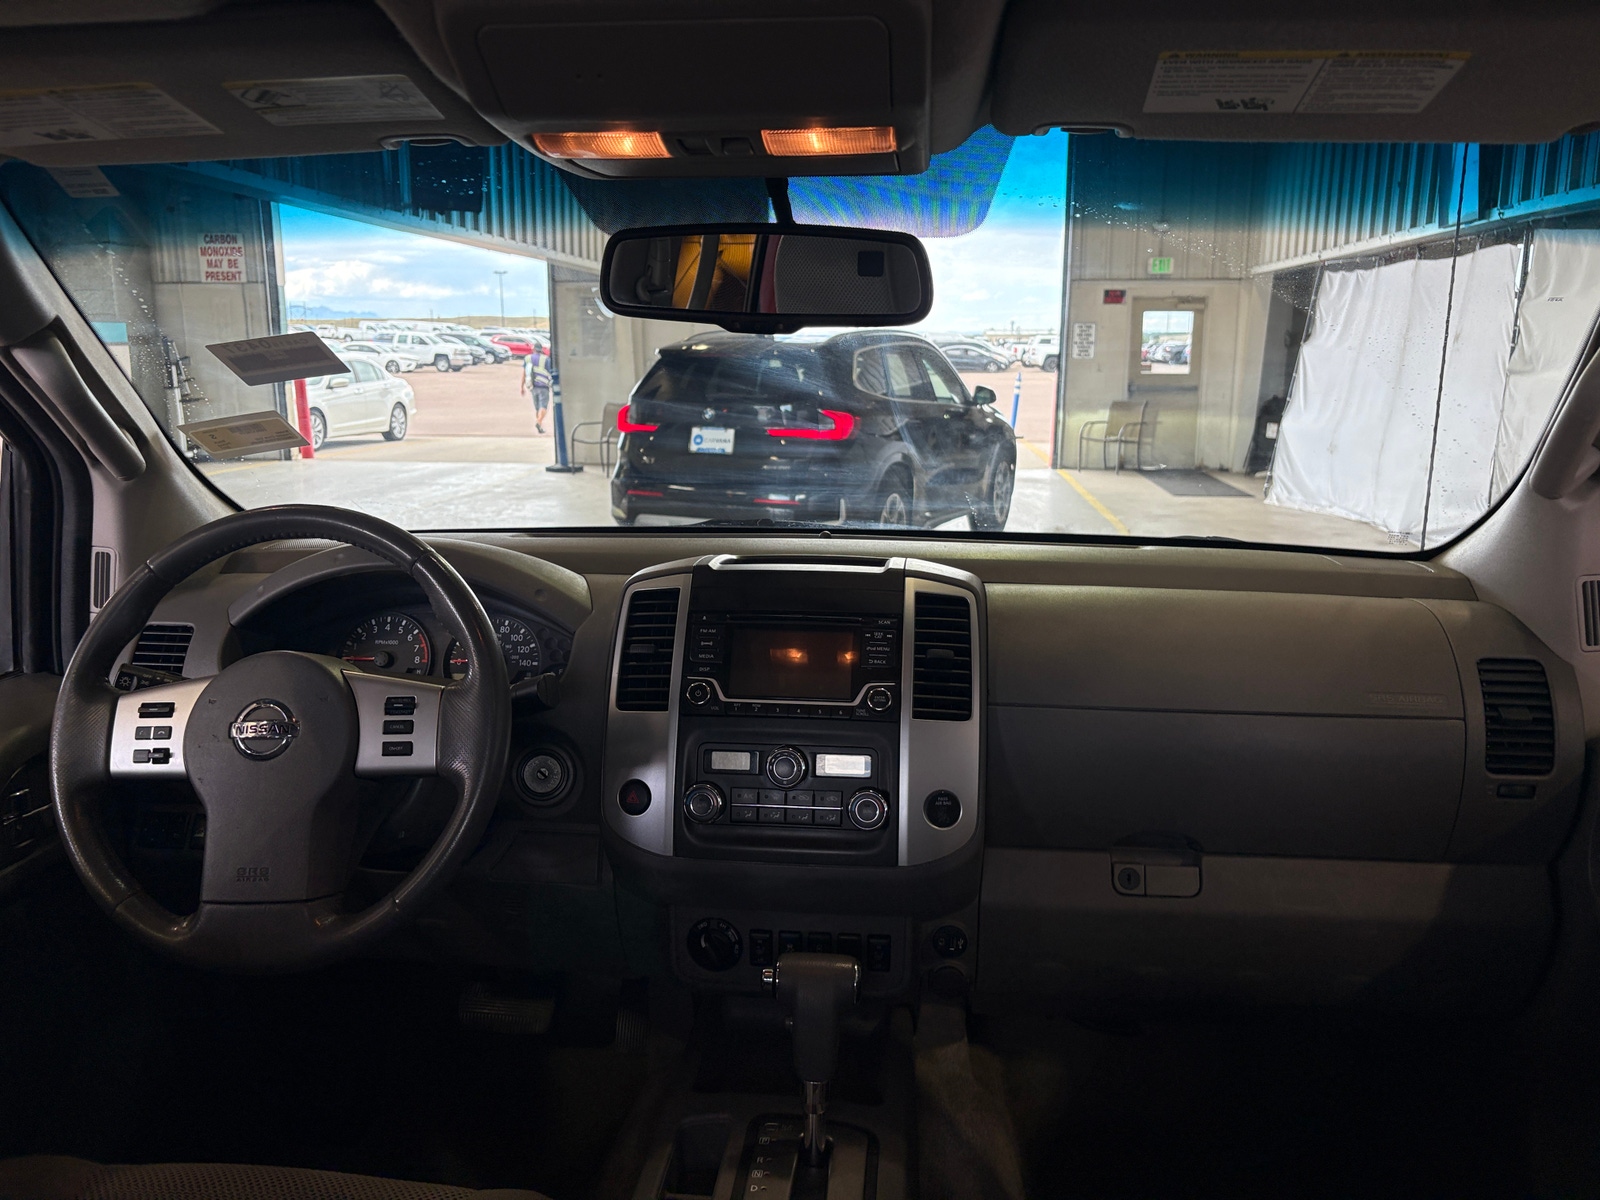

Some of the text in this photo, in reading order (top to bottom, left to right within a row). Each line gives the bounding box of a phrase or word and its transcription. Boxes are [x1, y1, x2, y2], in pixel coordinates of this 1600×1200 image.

[203, 234, 238, 245] CARBON
[200, 246, 243, 257] MONOXIDE
[206, 258, 239, 269] MAY BE
[1152, 257, 1171, 273] EXIT
[205, 271, 242, 281] PRESENT
[373, 626, 379, 634] 3
[385, 623, 391, 632] 4
[398, 626, 404, 634] 5
[499, 625, 511, 634] 80
[361, 632, 367, 640] 2
[407, 634, 413, 642] 6
[510, 634, 523, 642] 100
[413, 645, 420, 653] 7
[517, 645, 529, 654] 120
[414, 656, 421, 664] 8
[519, 659, 532, 667] 140
[236, 723, 290, 735] NISSAN
[236, 867, 270, 876] SRS
